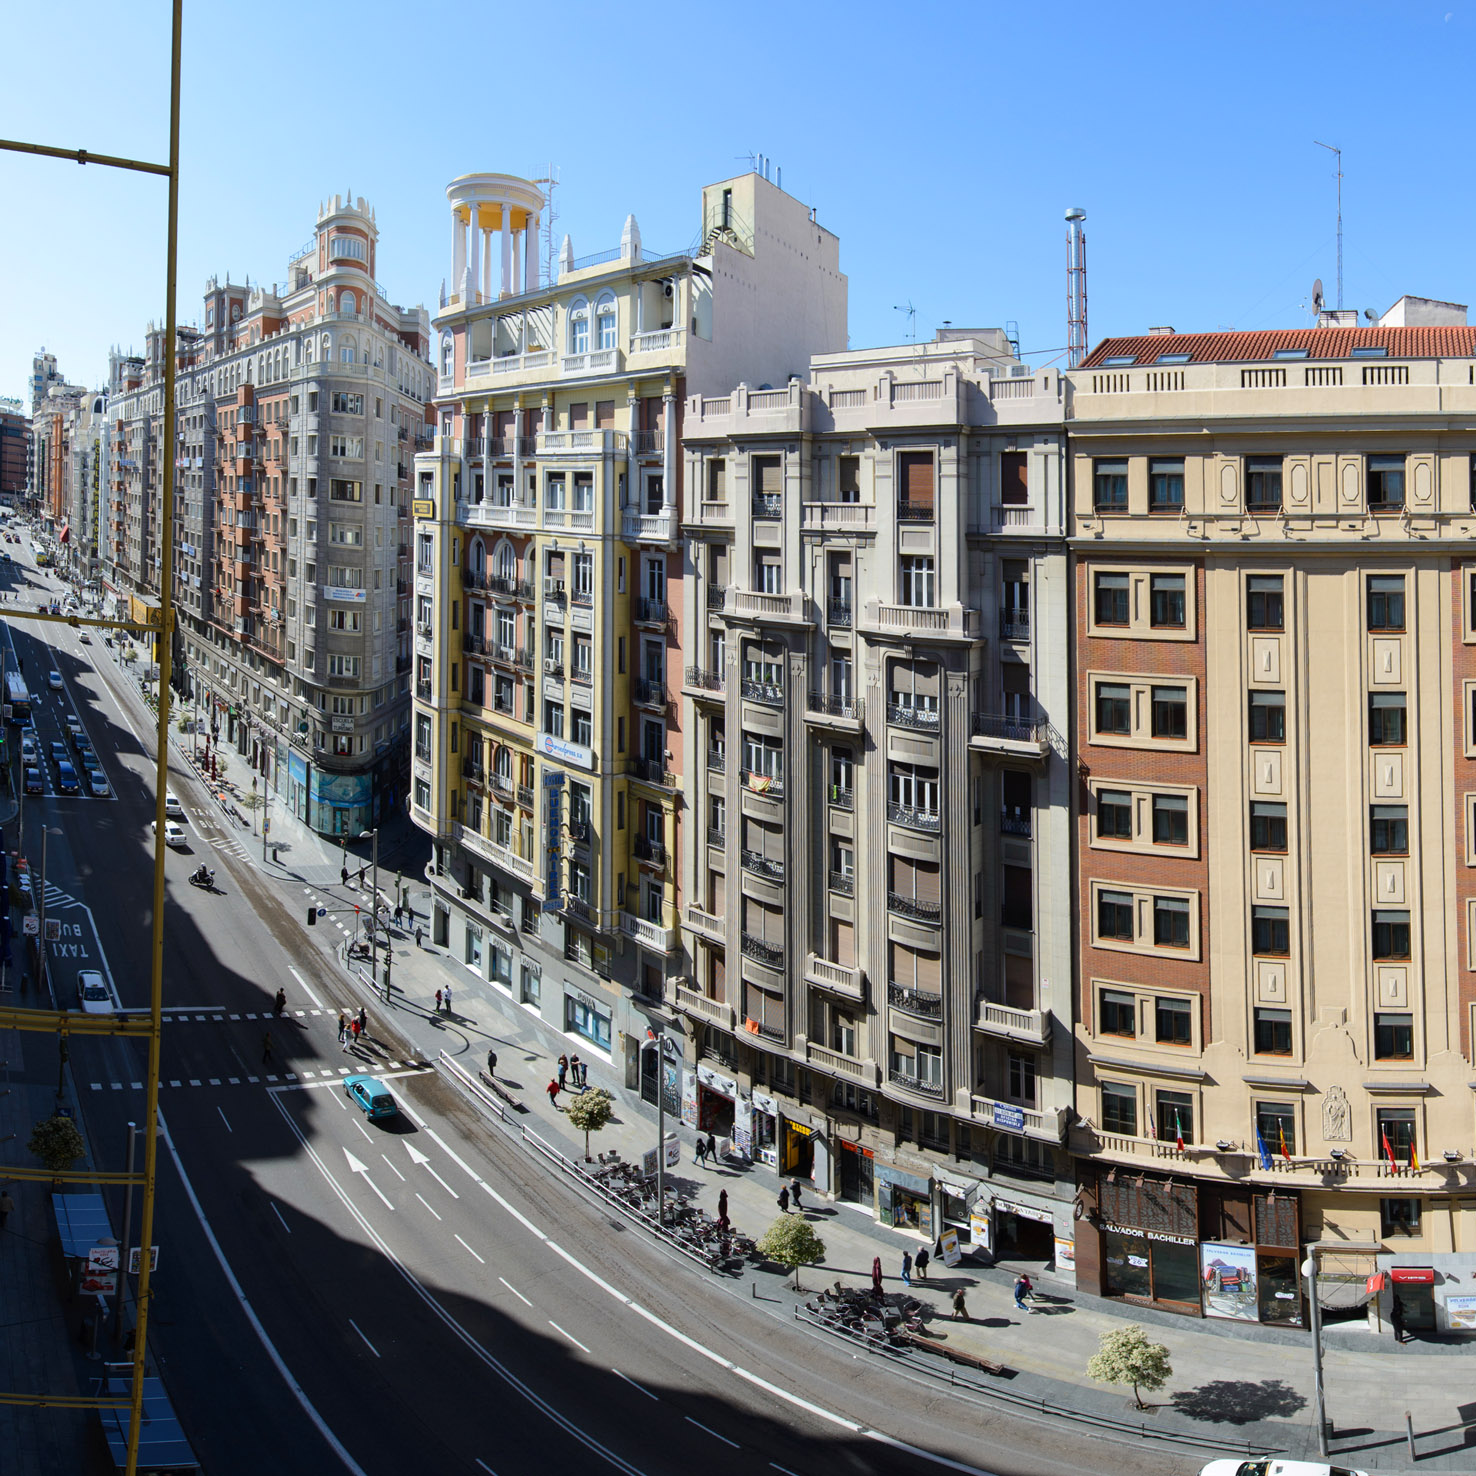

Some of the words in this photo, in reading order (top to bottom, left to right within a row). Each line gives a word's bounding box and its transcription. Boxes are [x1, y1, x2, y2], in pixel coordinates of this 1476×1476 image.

[190, 807, 216, 818] TAXI
[550, 788, 559, 847] BUENOS
[198, 820, 220, 829] BUS
[549, 853, 559, 899] AIRES
[60, 923, 82, 937] BU
[53, 943, 89, 958] TAXI
[996, 1117, 1021, 1128] DISPONIBLE
[1001, 1113, 1017, 1122] OFICINA
[1100, 1223, 1144, 1238] SALVADOR
[1147, 1232, 1195, 1247] BACHILLER
